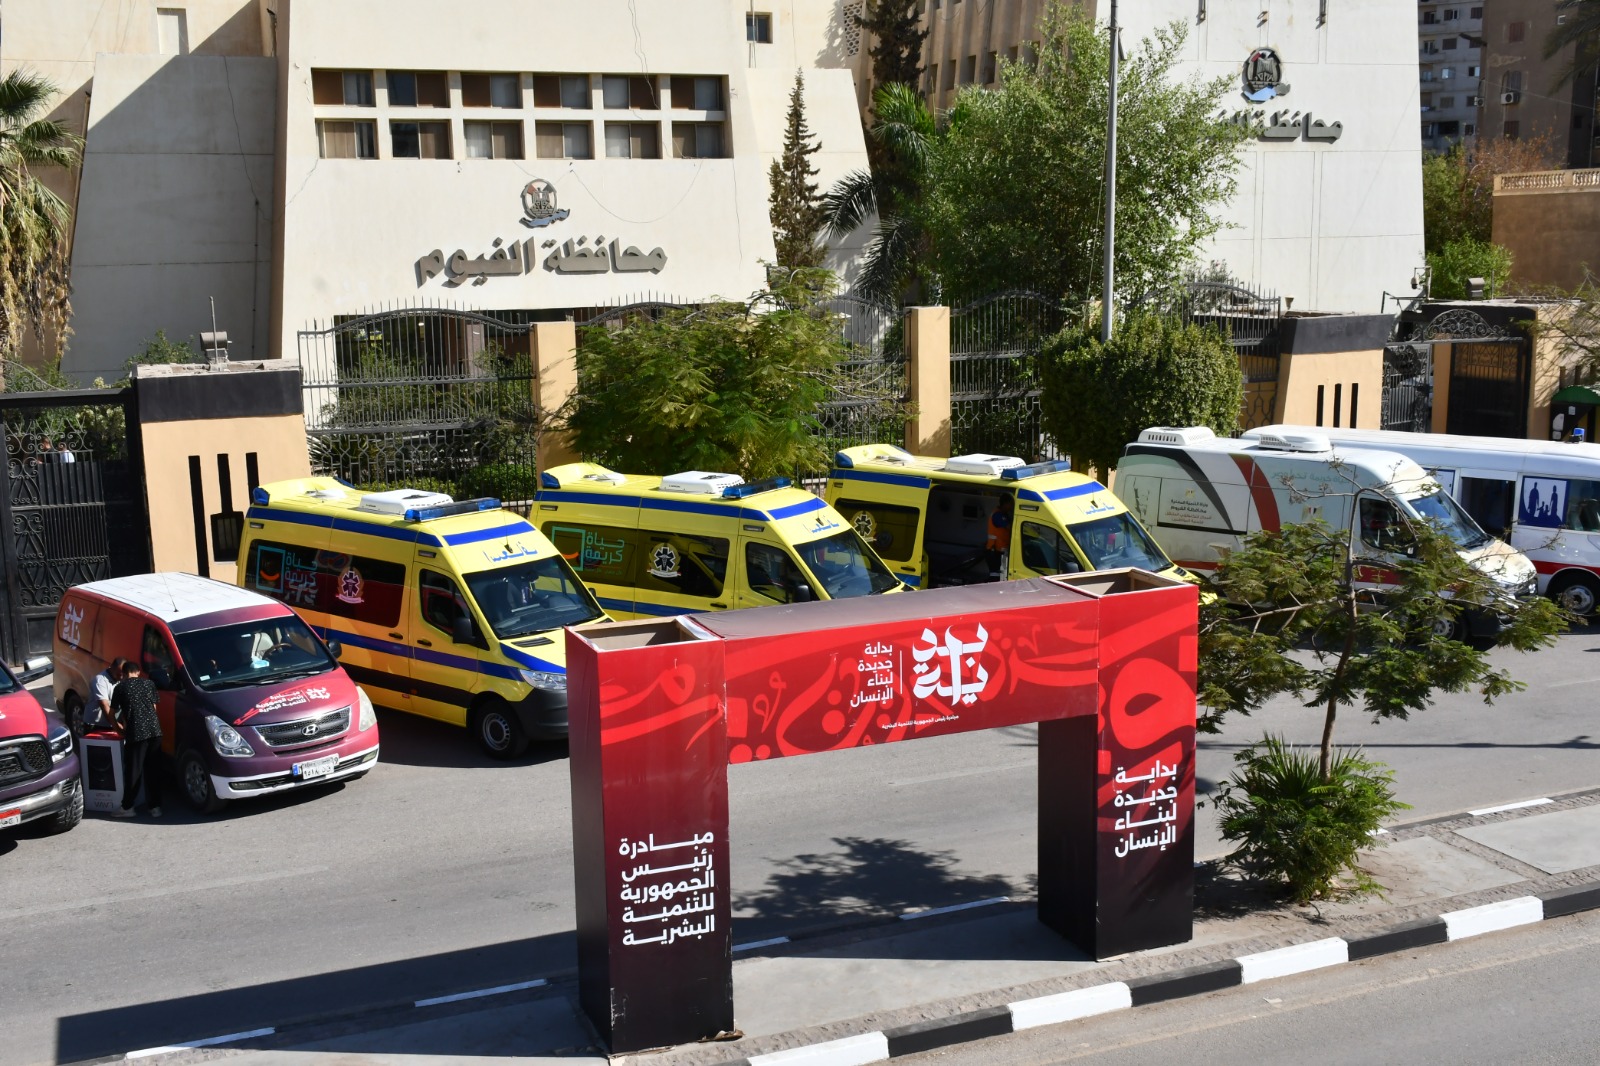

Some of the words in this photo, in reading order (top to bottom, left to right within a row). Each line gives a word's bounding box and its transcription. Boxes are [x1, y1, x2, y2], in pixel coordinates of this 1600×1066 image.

[414, 236, 536, 288] الفيوم
[543, 235, 668, 275] محافظة
[586, 532, 625, 550] حياة
[285, 551, 318, 571] حياة
[585, 546, 624, 564] كريمة
[285, 567, 317, 587] كريمة
[864, 642, 892, 658] بداية
[858, 659, 893, 673] جديدة
[867, 671, 893, 687] لبناء
[255, 698, 287, 709] الجمهورية
[269, 690, 301, 700] مبادرة
[850, 687, 893, 707] الإنسان
[881, 722, 898, 730] البشرية
[913, 717, 934, 725] الجمهورية
[1115, 760, 1177, 783] بداية
[1114, 786, 1177, 807] جديدة
[1115, 802, 1177, 830] لبناء
[619, 831, 714, 859] مبادرة
[1115, 825, 1176, 858] الإنسان
[622, 848, 713, 882] رئيس
[620, 869, 715, 904] الجمهورية
[622, 892, 714, 923] للتنمية
[622, 914, 715, 946] البشرية
